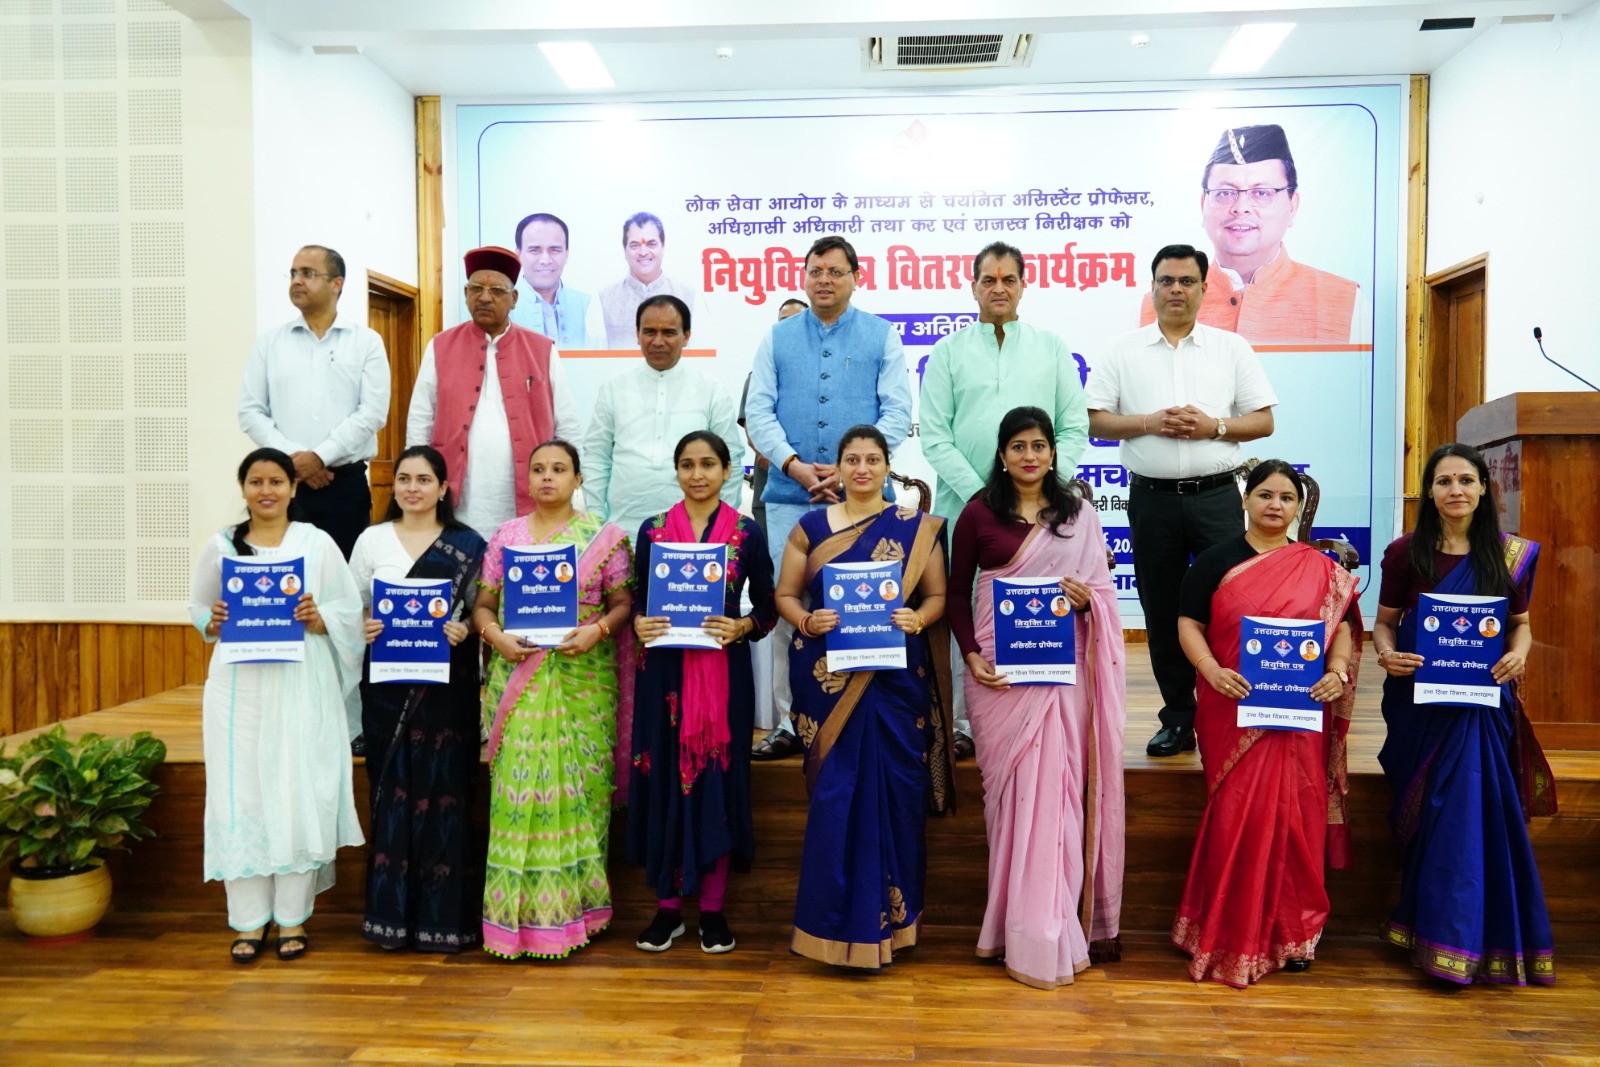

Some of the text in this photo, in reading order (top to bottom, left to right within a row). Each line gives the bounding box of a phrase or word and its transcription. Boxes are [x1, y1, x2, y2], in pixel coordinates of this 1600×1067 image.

[685, 187, 1155, 212] लोक सेवा आयोग के माध्यम से चयनित असिस्टेंट प्रोफेसर,
[708, 211, 1132, 236] अधिशासी अधिकारी तथा कर एवं राजस्व निरीक्षक को
